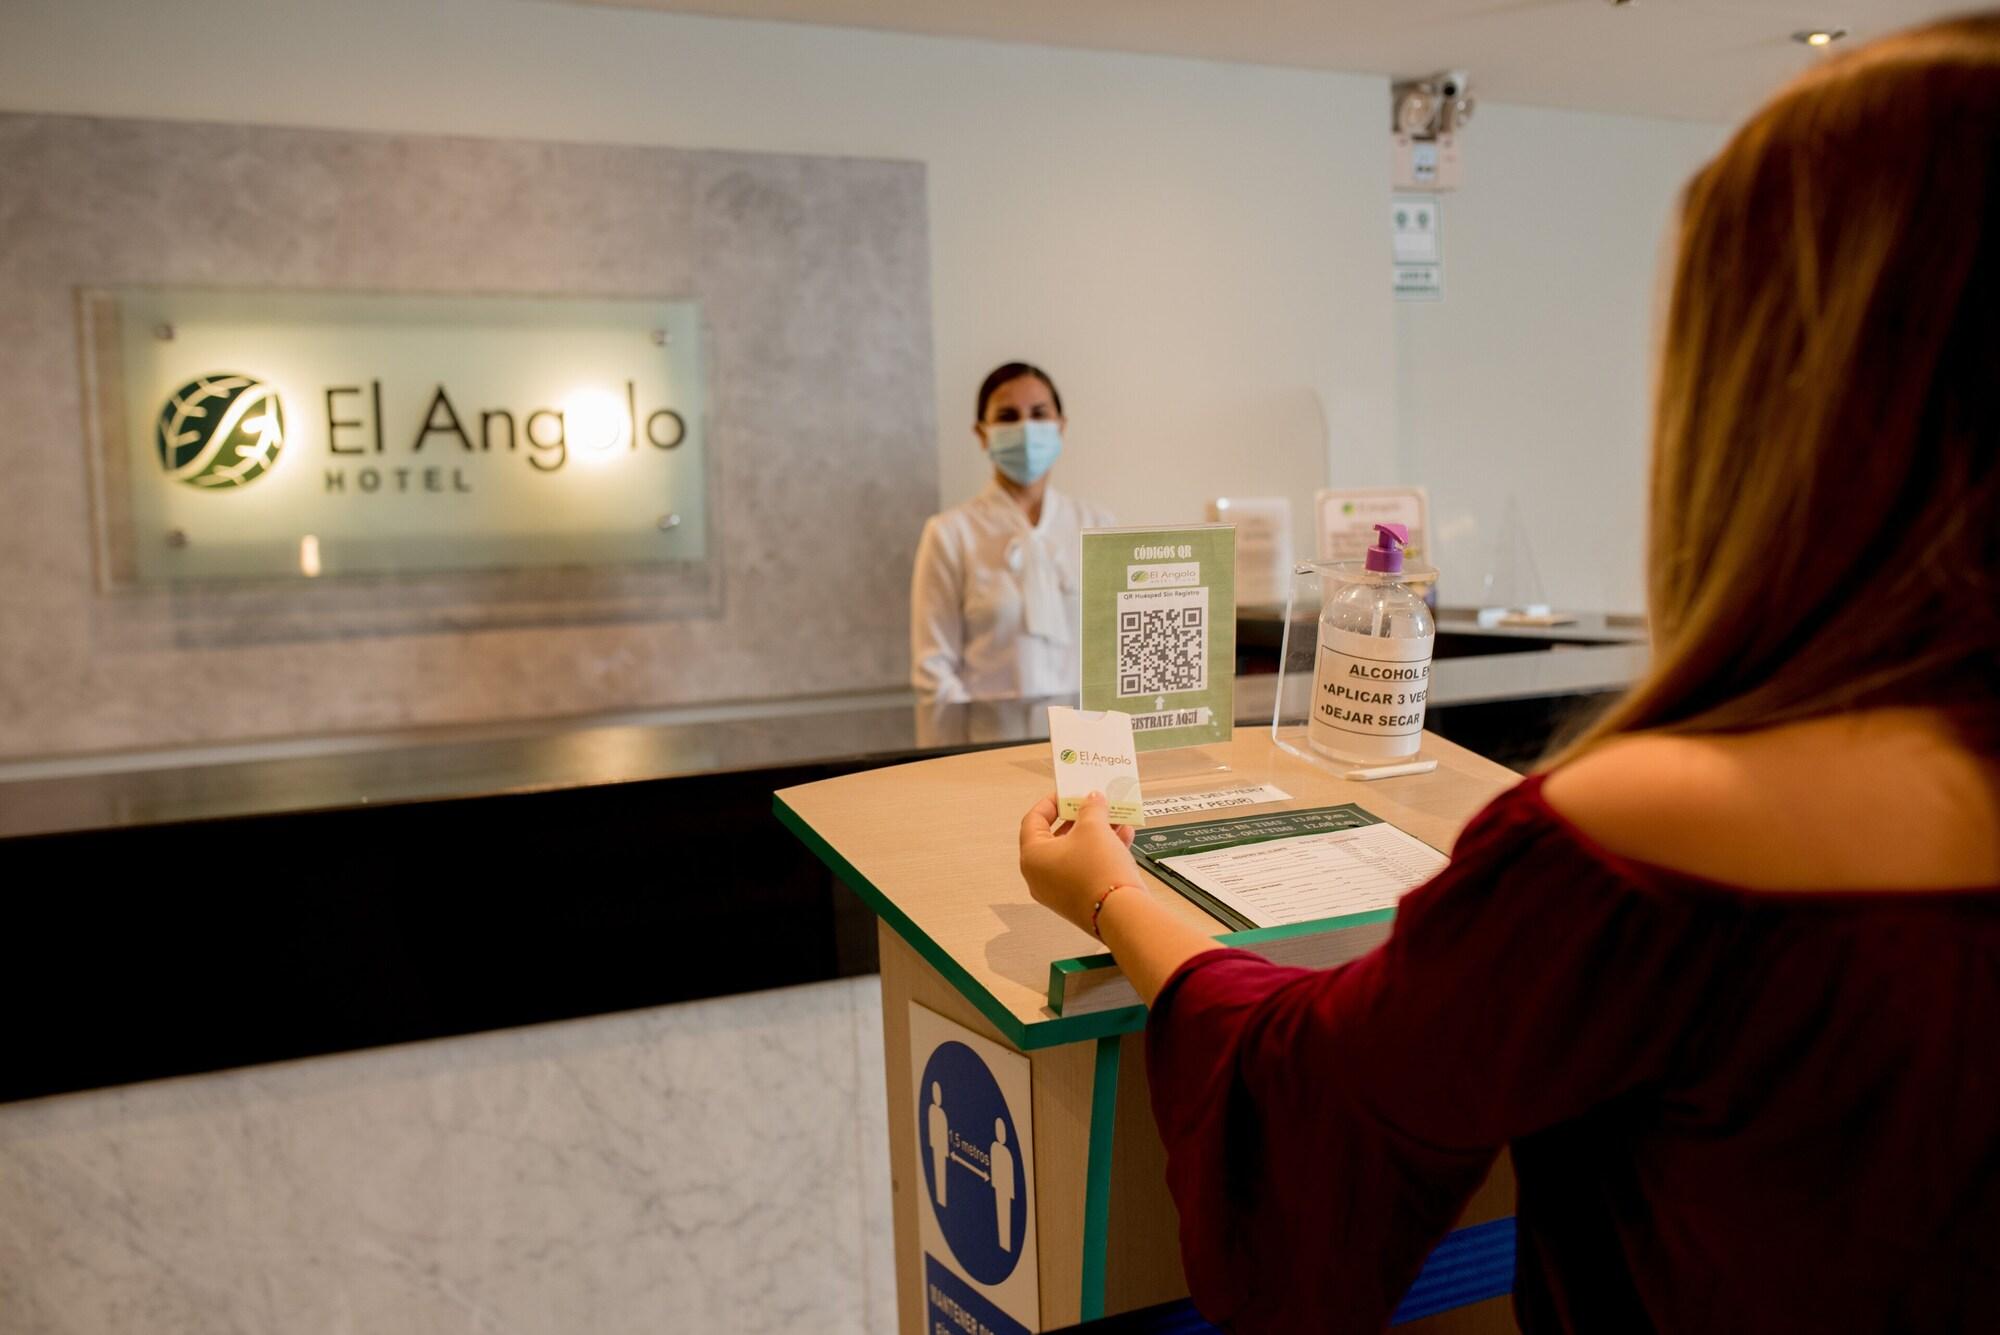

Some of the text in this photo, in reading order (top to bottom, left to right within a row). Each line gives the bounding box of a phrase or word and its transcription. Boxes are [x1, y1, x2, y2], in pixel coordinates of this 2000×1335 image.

[325, 381, 384, 455] El
[326, 467, 472, 493] HOTEL
[1134, 545, 1192, 560] CÓDIGOS QR
[1150, 570, 1196, 579] El Angolo
[1163, 590, 1173, 598] Sin
[1175, 589, 1200, 598] Registro
[1349, 664, 1419, 680] ALCOHOL
[1397, 694, 1405, 704] 3
[1378, 713, 1420, 726] SECAR
[1080, 751, 1131, 766] El Angolo
[961, 1140, 989, 1166] metros
